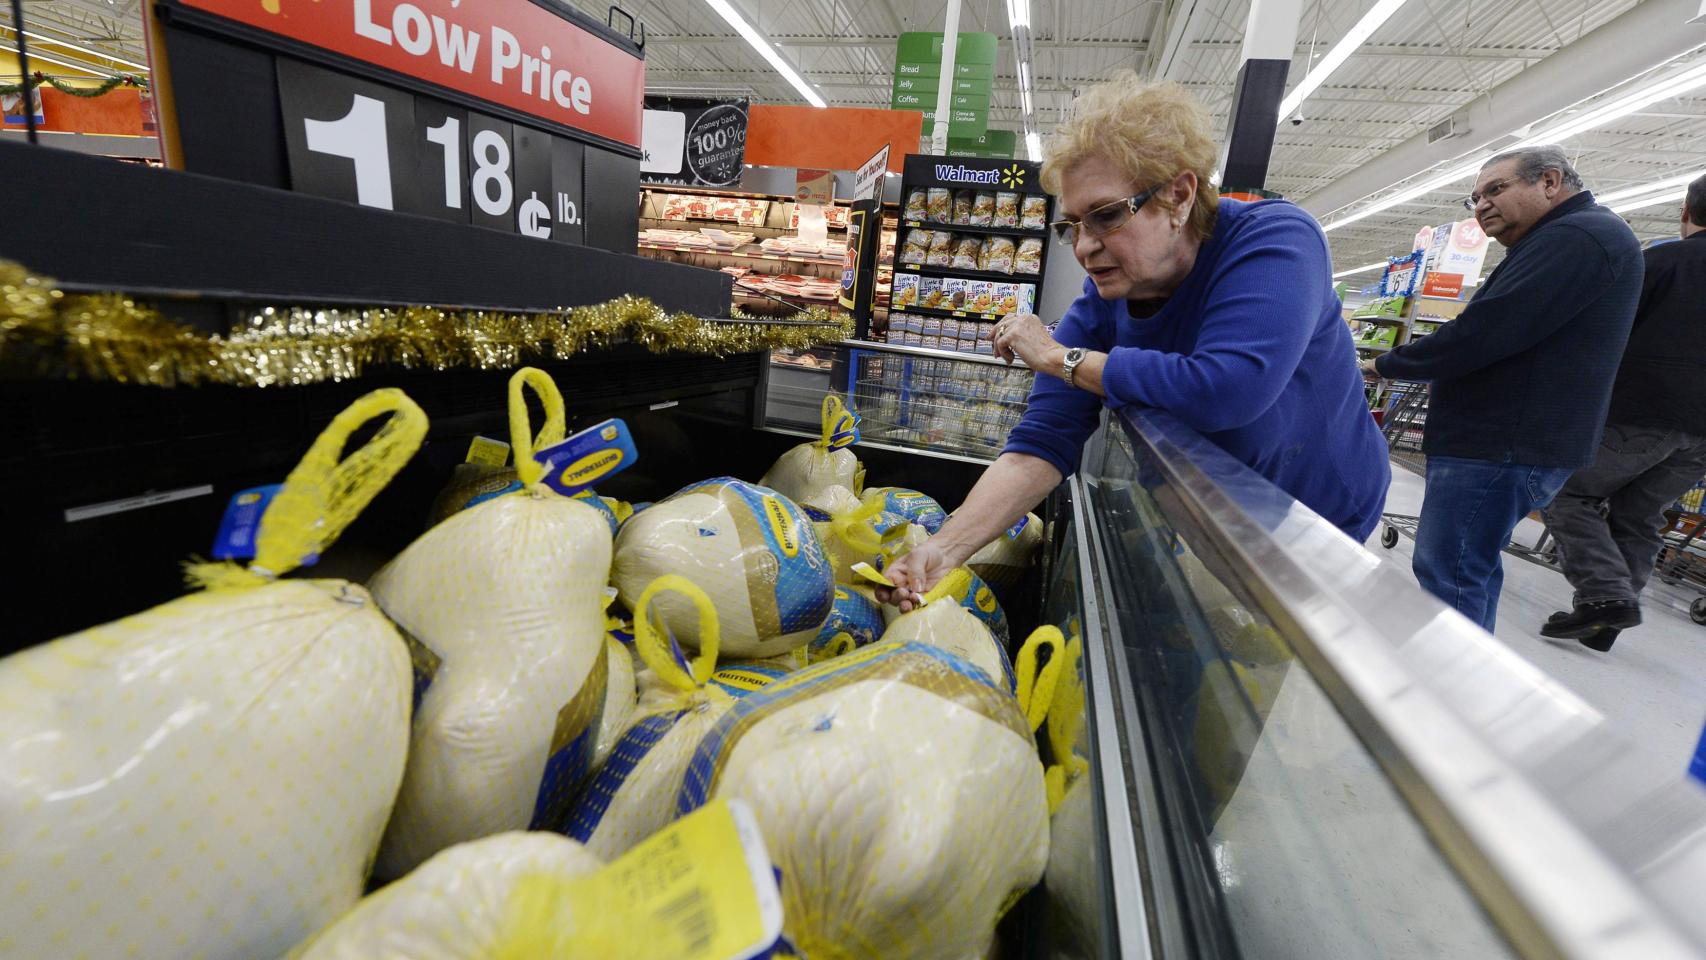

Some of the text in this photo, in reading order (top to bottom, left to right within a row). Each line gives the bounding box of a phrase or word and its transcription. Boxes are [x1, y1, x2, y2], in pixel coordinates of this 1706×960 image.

[354, 0, 592, 115] Low Price
[900, 65, 920, 74] Bread
[898, 80, 914, 90] Jelly
[897, 95, 919, 103] Coffee
[697, 113, 737, 131] money back
[693, 123, 745, 154] 100%
[304, 94, 394, 211] 1
[558, 192, 582, 226] lb.
[949, 150, 977, 158] Condiments
[935, 164, 999, 184] Walmart
[1462, 225, 1480, 245] $4
[898, 276, 911, 284] Little
[947, 281, 961, 289] Little
[972, 283, 986, 291] Little
[567, 453, 619, 481] BUTTERBALL
[769, 500, 794, 550] BUTTERBALL
